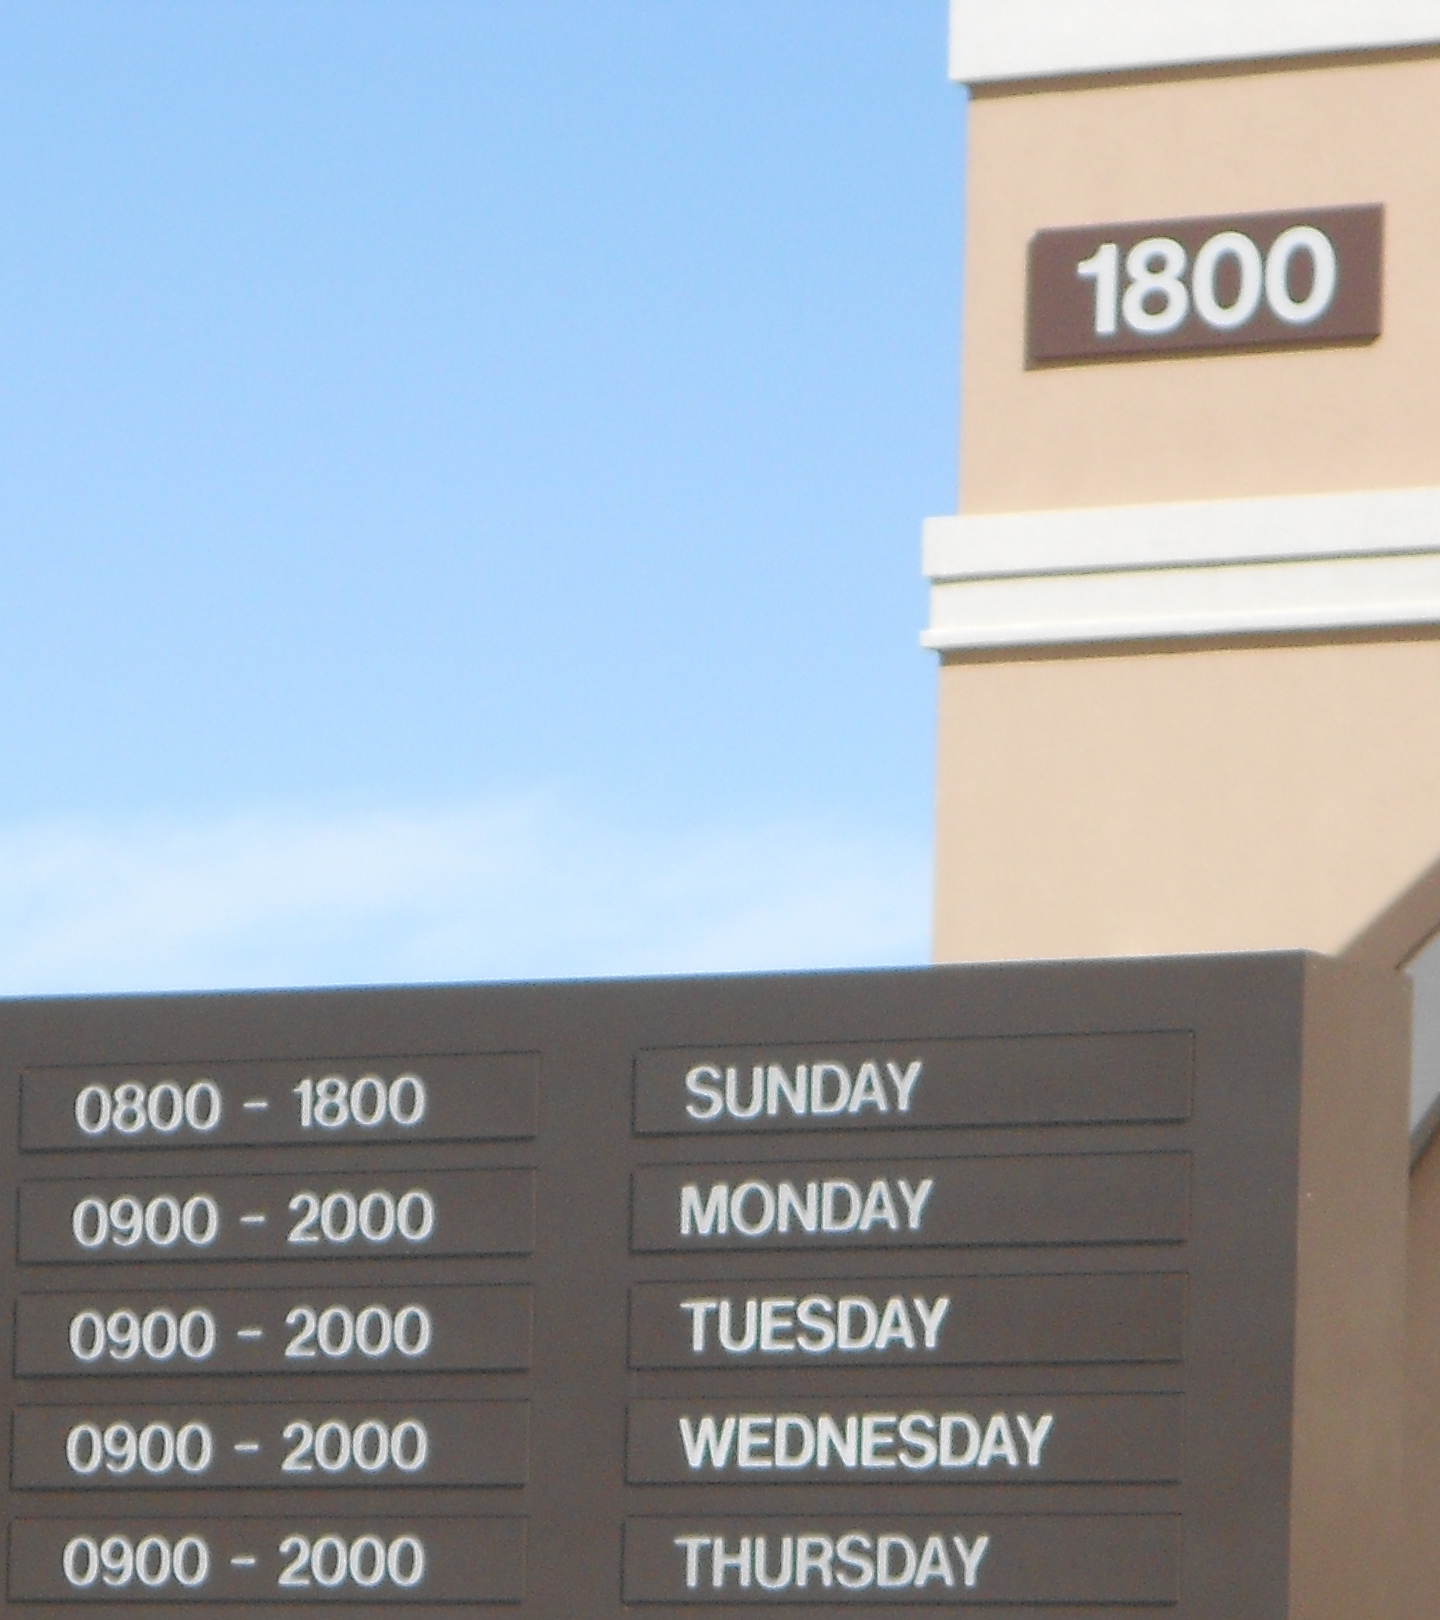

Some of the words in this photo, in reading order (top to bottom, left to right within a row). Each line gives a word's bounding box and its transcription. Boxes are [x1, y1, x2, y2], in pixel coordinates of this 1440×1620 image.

[1076, 224, 1336, 335] 1800
[75, 1081, 222, 1135] 0800
[293, 1074, 427, 1129] 1800
[685, 1060, 922, 1121] SUNDAY
[72, 1195, 220, 1248] 0900
[287, 1190, 435, 1244] 2000
[680, 1178, 934, 1237] MONDAY
[69, 1309, 216, 1362] 0900
[284, 1305, 432, 1358] 2000
[679, 1295, 950, 1354] TUESDAY
[66, 1422, 214, 1475] 0900
[281, 1419, 429, 1473] 2000
[679, 1411, 1054, 1470] WEDNESDAY
[63, 1535, 210, 1587] 0900
[278, 1534, 426, 1588] 2000
[673, 1532, 989, 1590] THURSDAY
